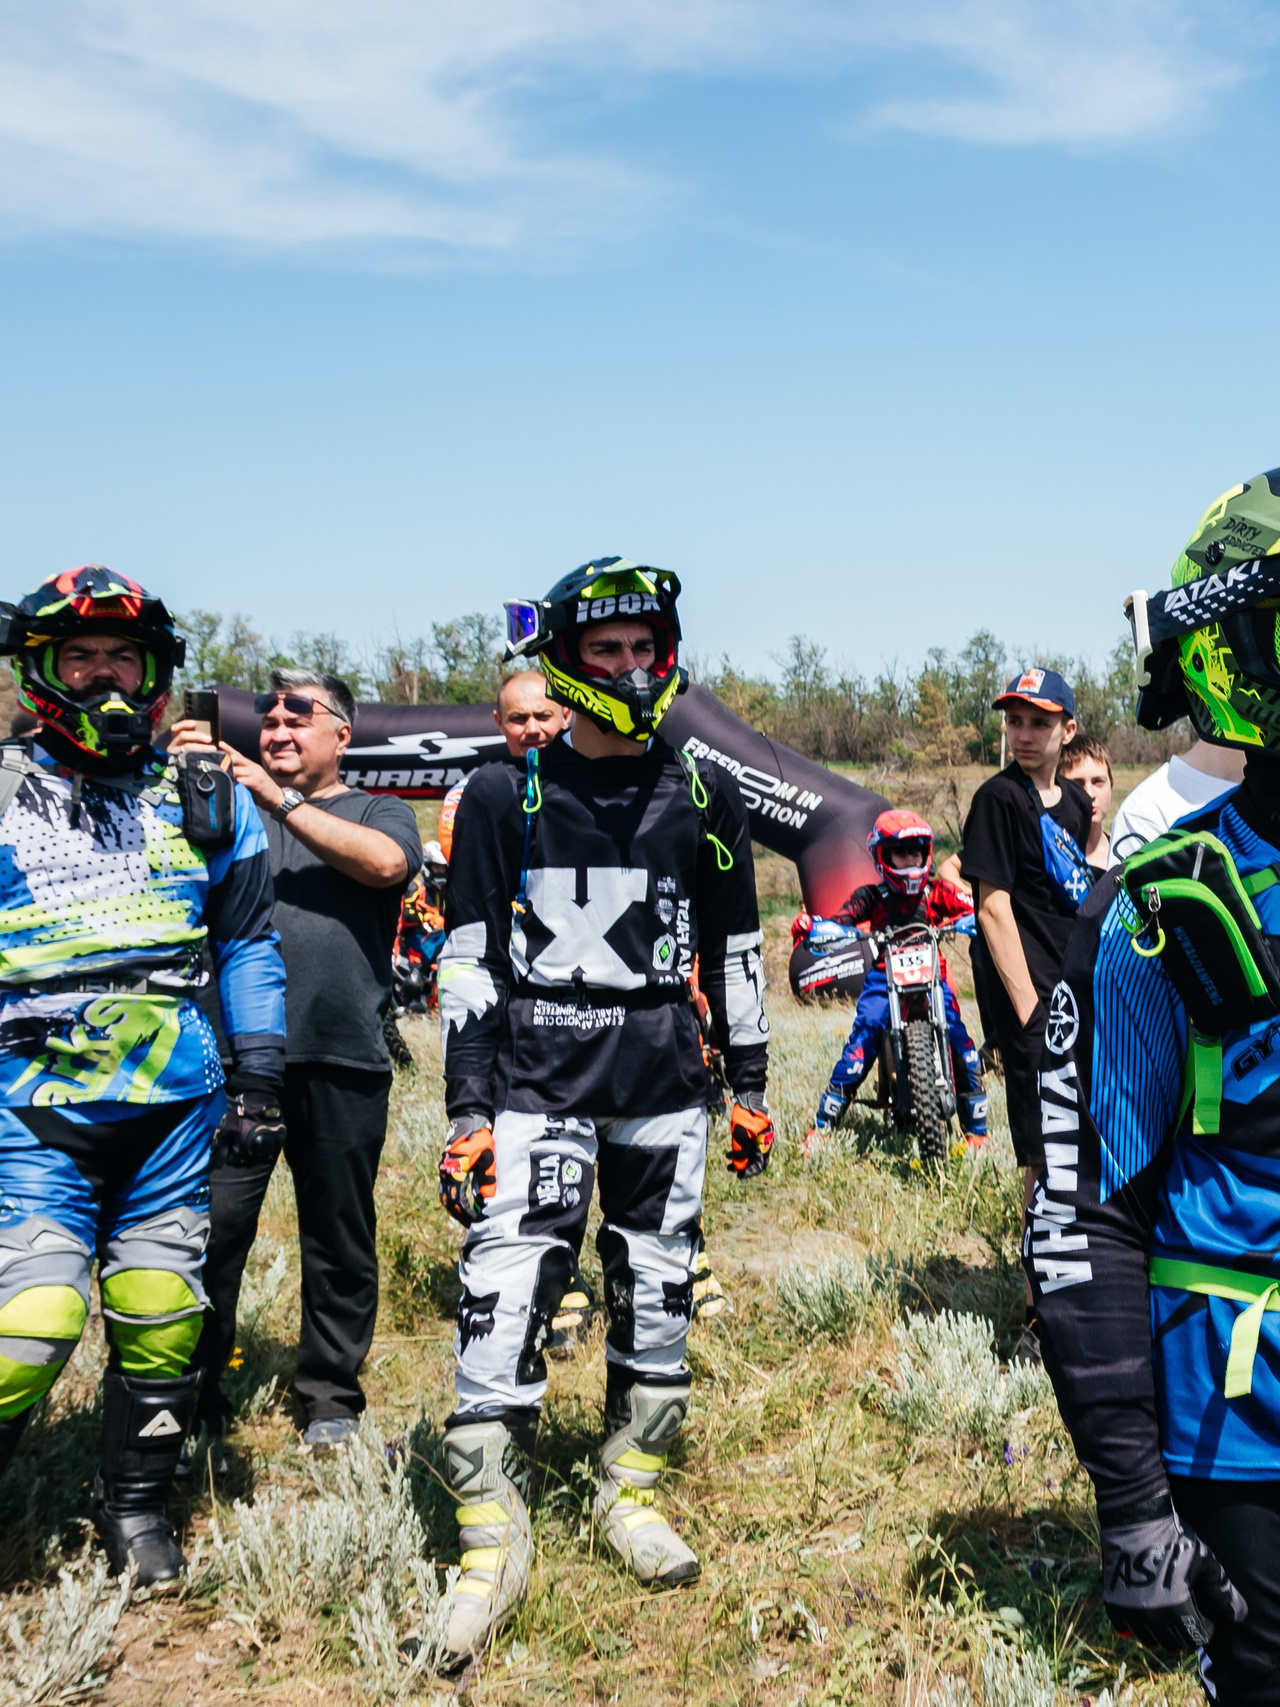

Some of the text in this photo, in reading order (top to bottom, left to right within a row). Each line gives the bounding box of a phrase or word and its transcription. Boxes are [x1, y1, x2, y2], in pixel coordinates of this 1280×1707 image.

[1222, 516, 1262, 540] DIRTY
[339, 768, 479, 787] HARM
[739, 786, 808, 830] OTION
[796, 790, 823, 811] IN
[898, 955, 925, 969] 135
[1026, 1060, 1093, 1295] YAMAHA
